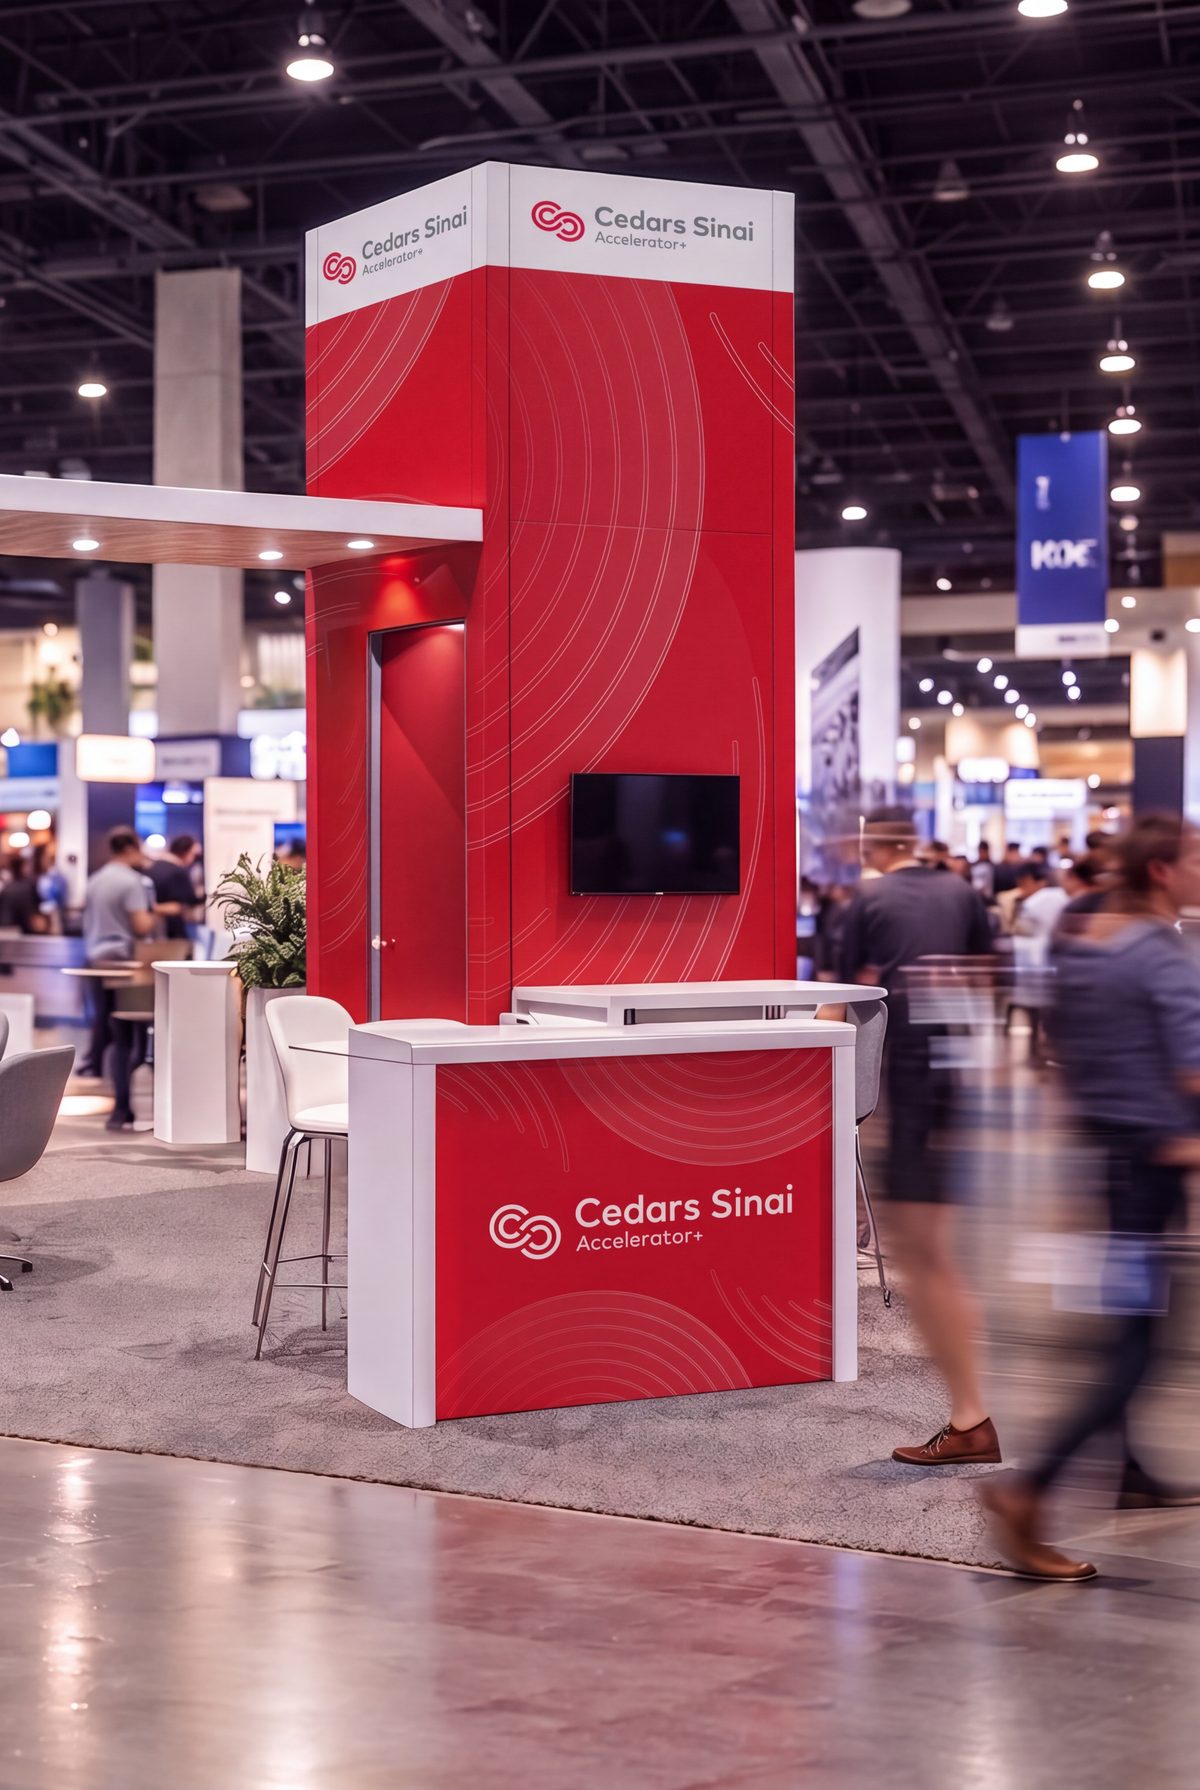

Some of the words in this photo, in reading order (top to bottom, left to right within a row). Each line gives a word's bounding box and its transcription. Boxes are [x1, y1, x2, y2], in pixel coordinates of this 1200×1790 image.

[361, 230, 420, 261] Cedars
[424, 204, 468, 240] Sinai
[594, 206, 687, 235] Cedars
[692, 215, 755, 242] Sinai
[594, 231, 688, 250] Accelerator+
[575, 1194, 701, 1228] Cedars
[711, 1184, 794, 1219] Sinai
[576, 1230, 704, 1252] Accelerator+
